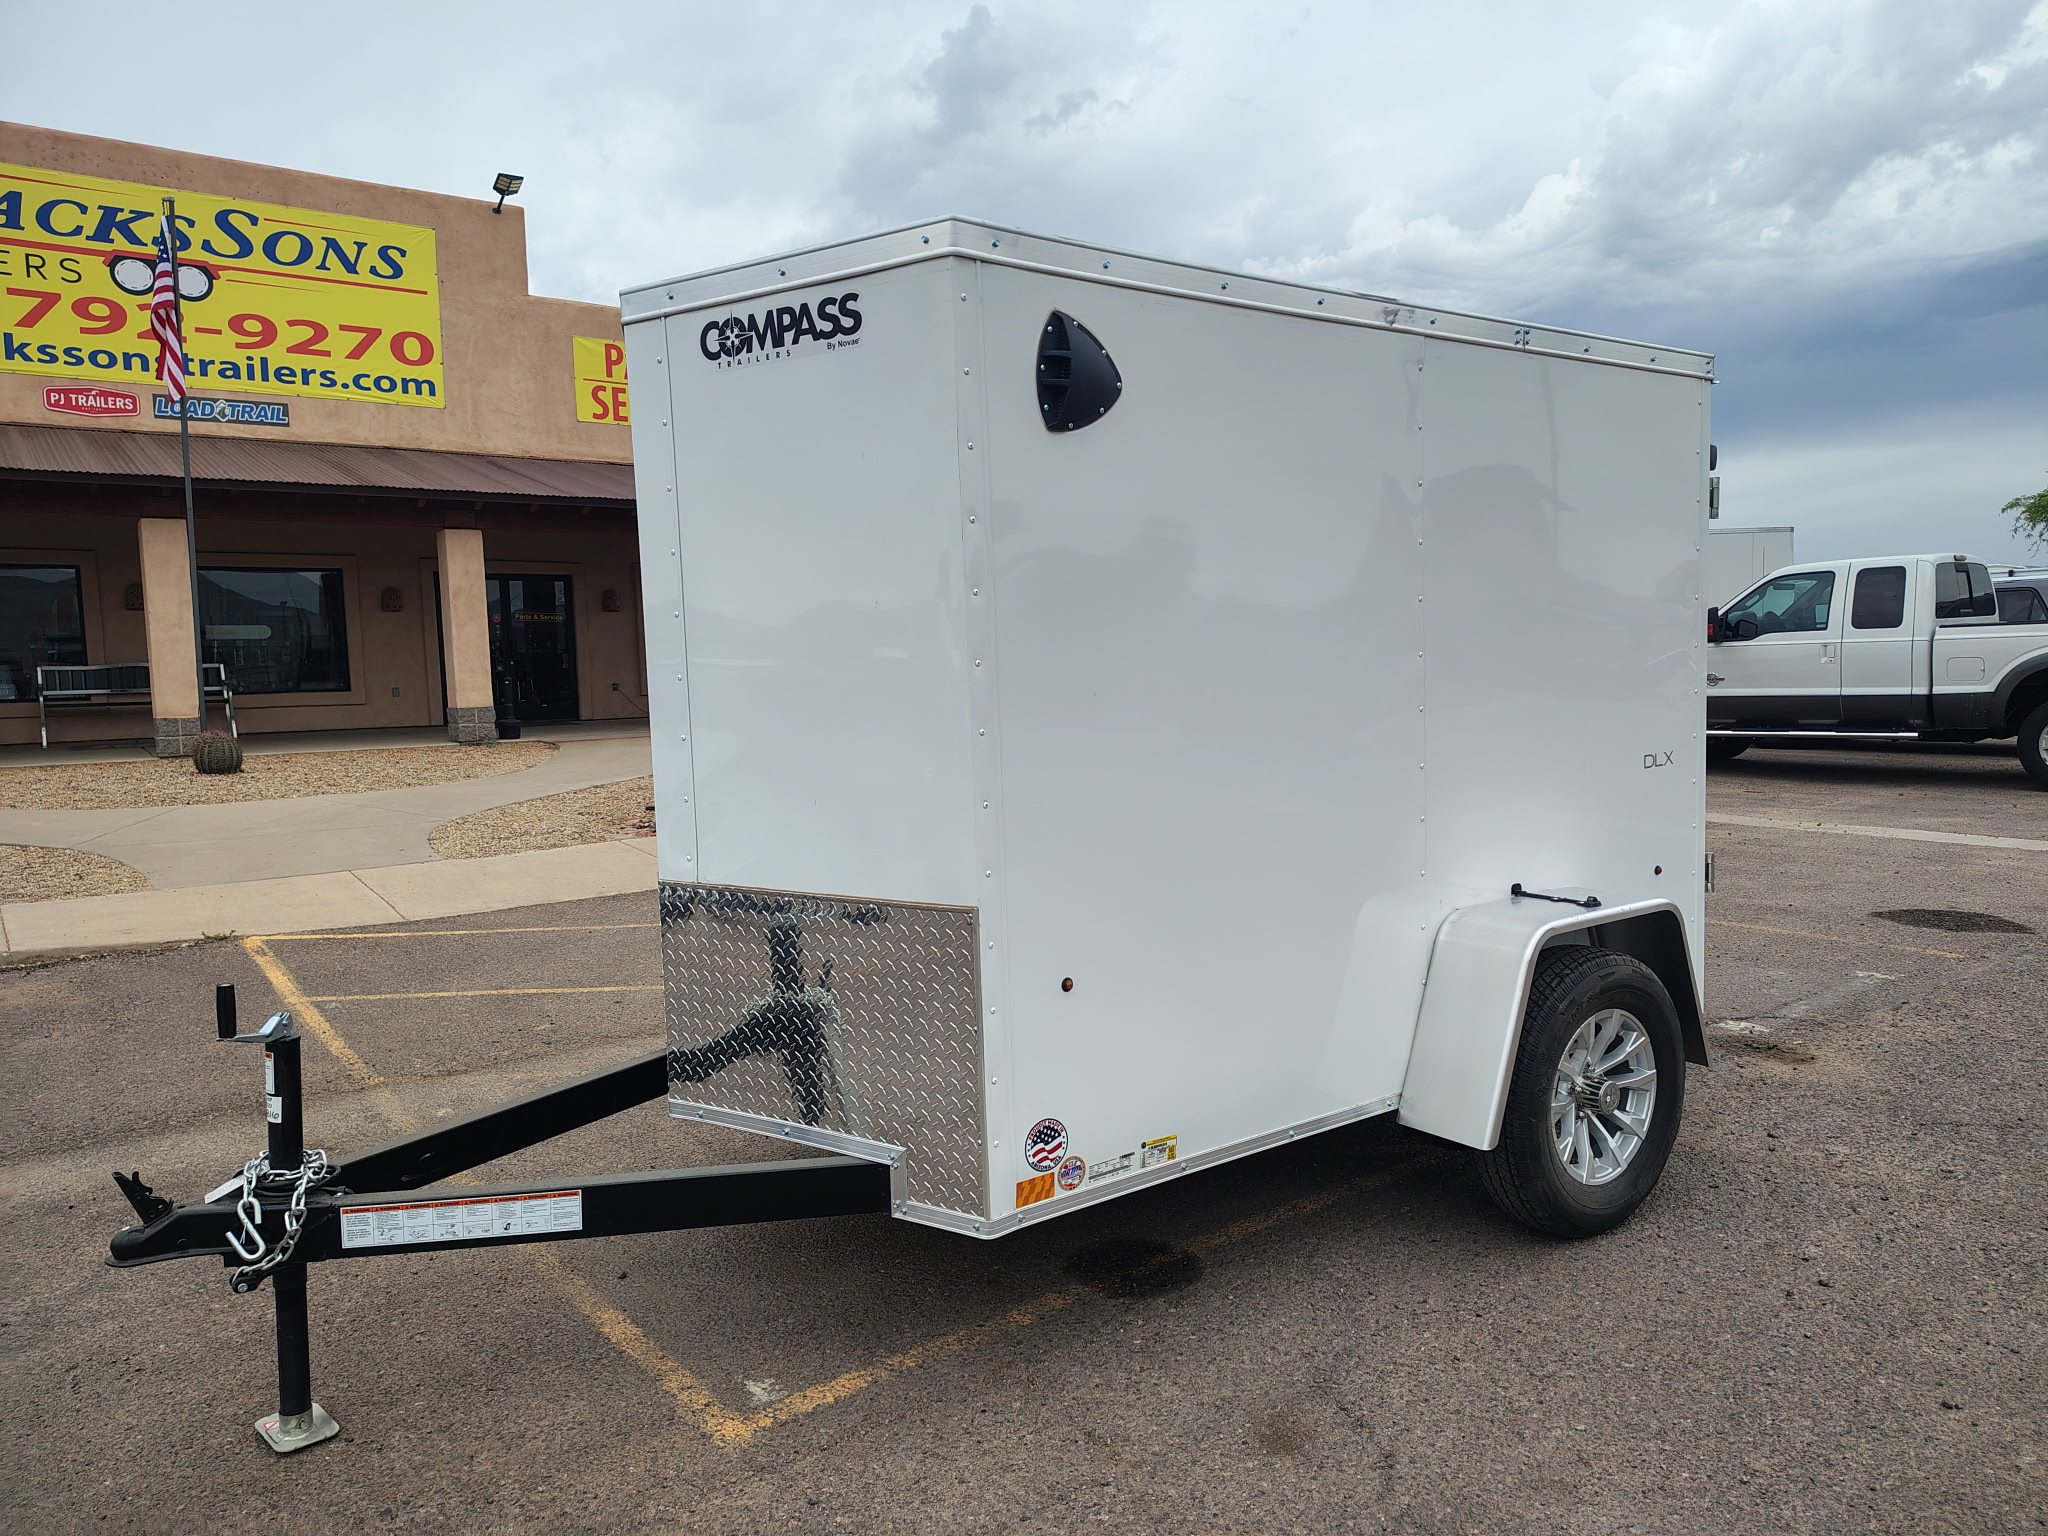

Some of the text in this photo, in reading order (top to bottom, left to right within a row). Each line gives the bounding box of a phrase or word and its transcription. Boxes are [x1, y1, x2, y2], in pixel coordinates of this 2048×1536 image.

[700, 292, 863, 362] COMPASS
[826, 341, 835, 351] By
[3, 332, 437, 397] kssontrailers.com
[604, 343, 628, 380] P
[717, 350, 791, 370] TRAILERS
[50, 392, 134, 410] PJ TRAILERS
[155, 397, 288, 424] LOAD TRAIL
[591, 385, 629, 422] SE
[1643, 750, 1674, 769] DLX
